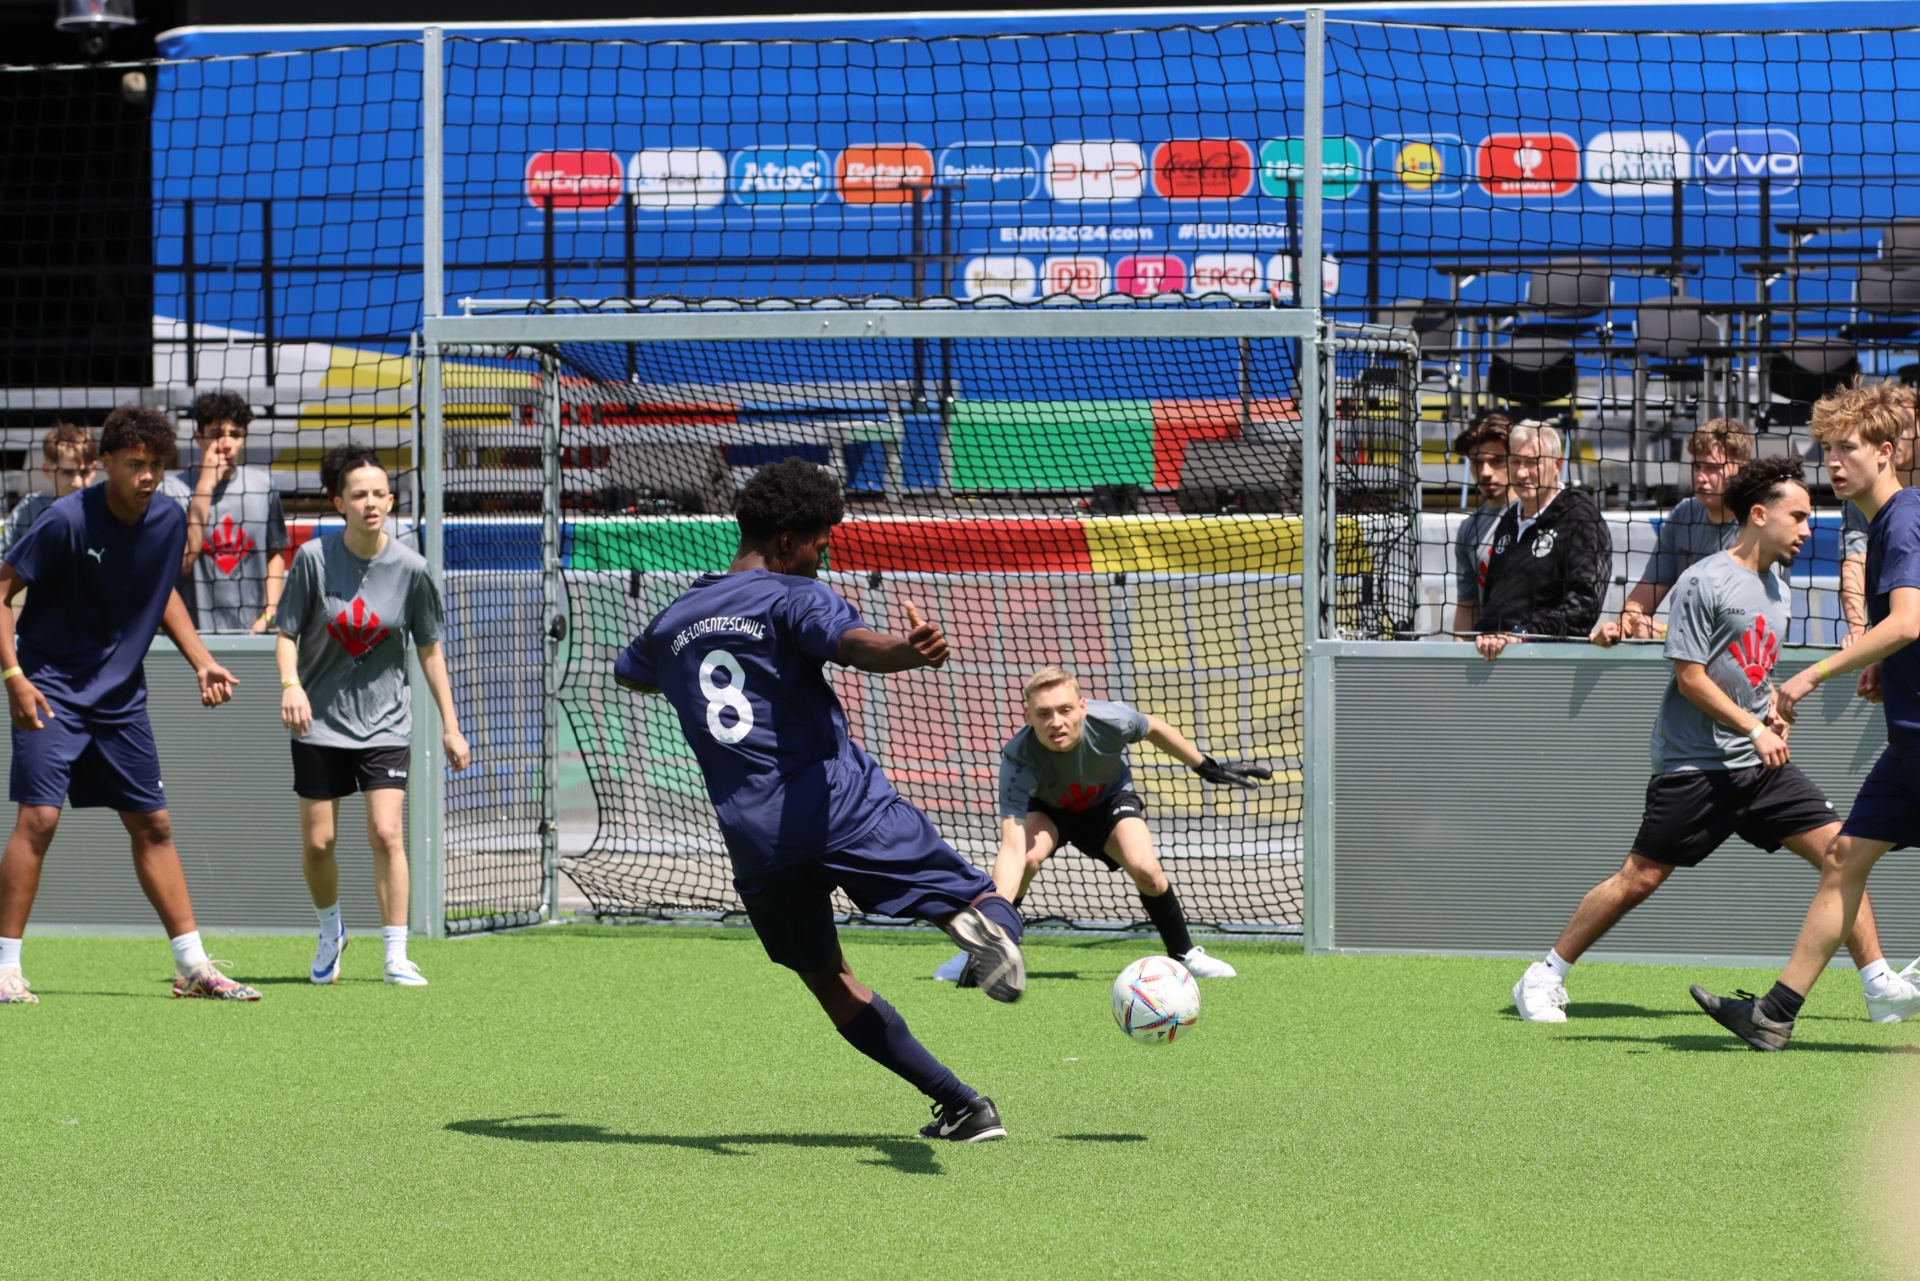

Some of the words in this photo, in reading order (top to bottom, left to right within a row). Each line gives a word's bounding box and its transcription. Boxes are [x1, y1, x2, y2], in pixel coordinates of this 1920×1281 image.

[844, 163, 925, 183] Betano
[944, 165, 1035, 183] Booking.com
[1265, 160, 1356, 177] Hisse
[1000, 224, 1154, 242] EURO2024.com
[1058, 267, 1093, 290] DB
[1137, 261, 1165, 294] T
[1195, 267, 1256, 287] ERGO
[1726, 607, 1746, 616] JAKO
[670, 616, 767, 656] LORE-LORENTZ-SCHULE
[698, 649, 754, 745] 8
